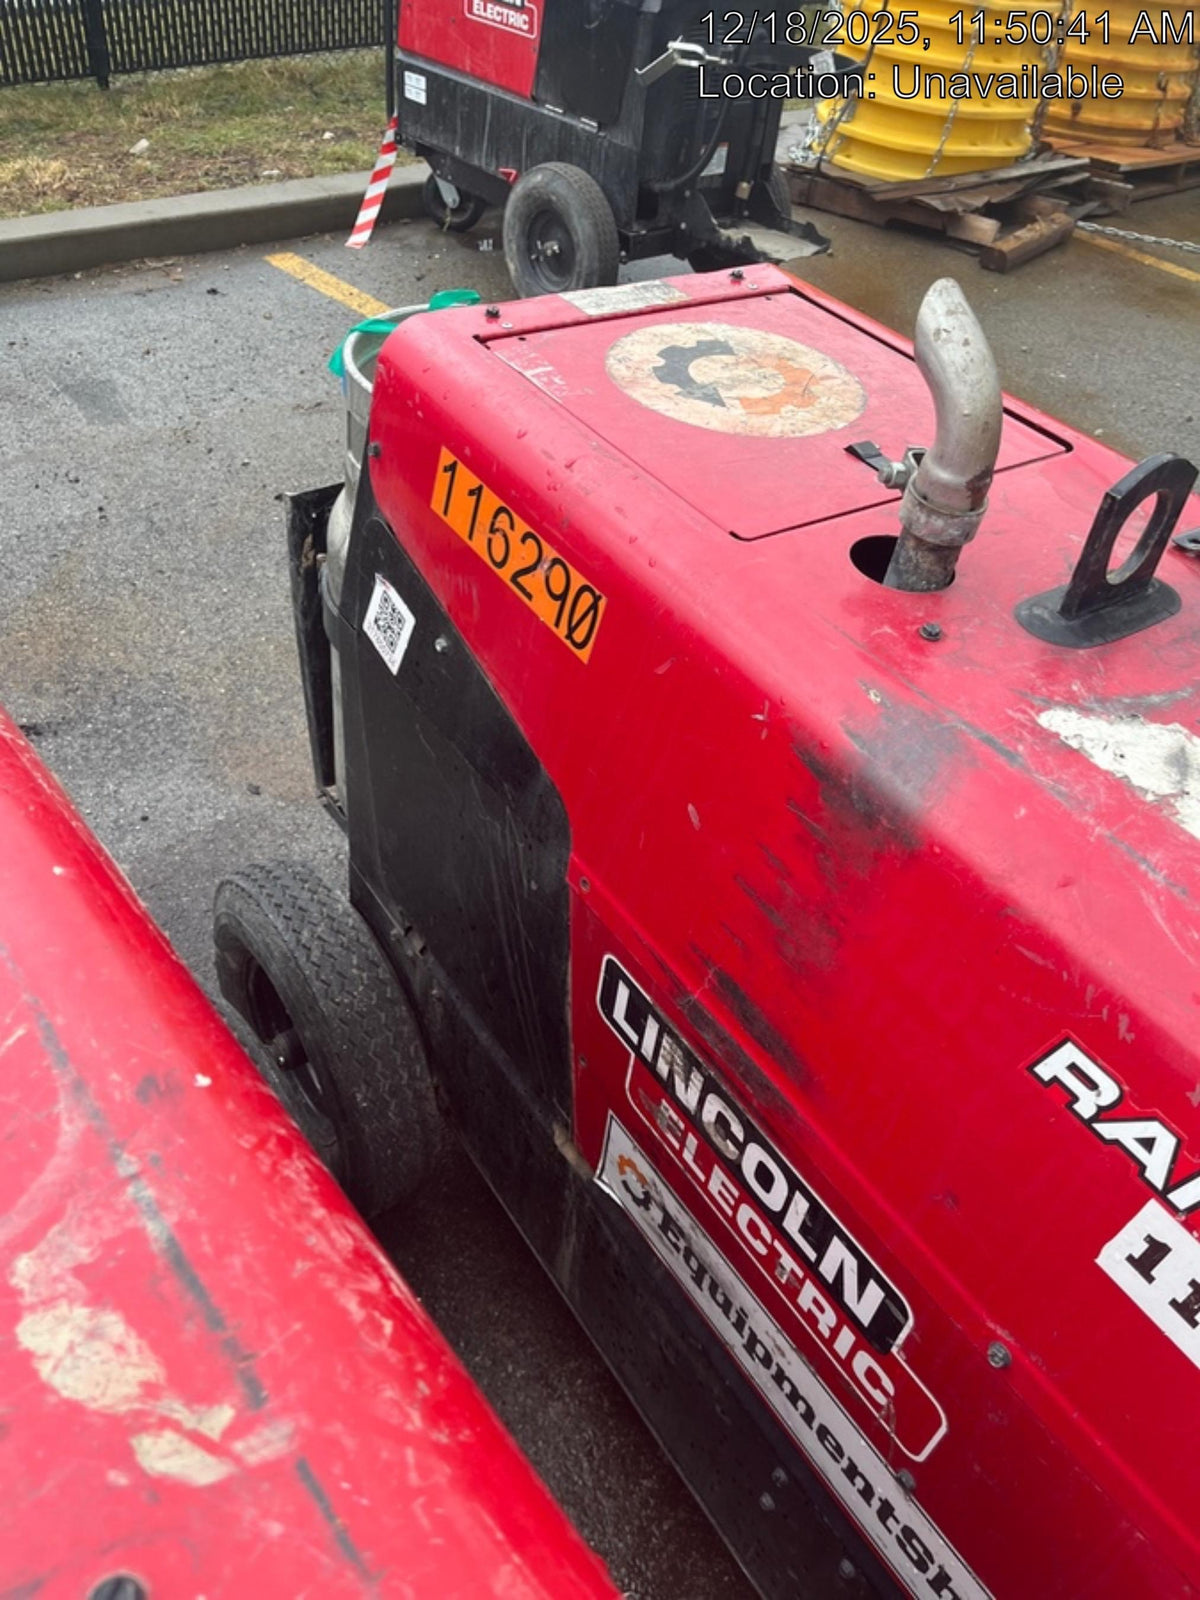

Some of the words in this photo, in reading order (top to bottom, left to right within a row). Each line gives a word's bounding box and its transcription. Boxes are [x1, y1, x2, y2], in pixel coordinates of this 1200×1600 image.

[473, 0, 529, 30] ELECTRIC
[440, 459, 602, 651] 116290
[613, 979, 886, 1328] LINCOLN
[654, 1098, 895, 1408] ELECTRIC
